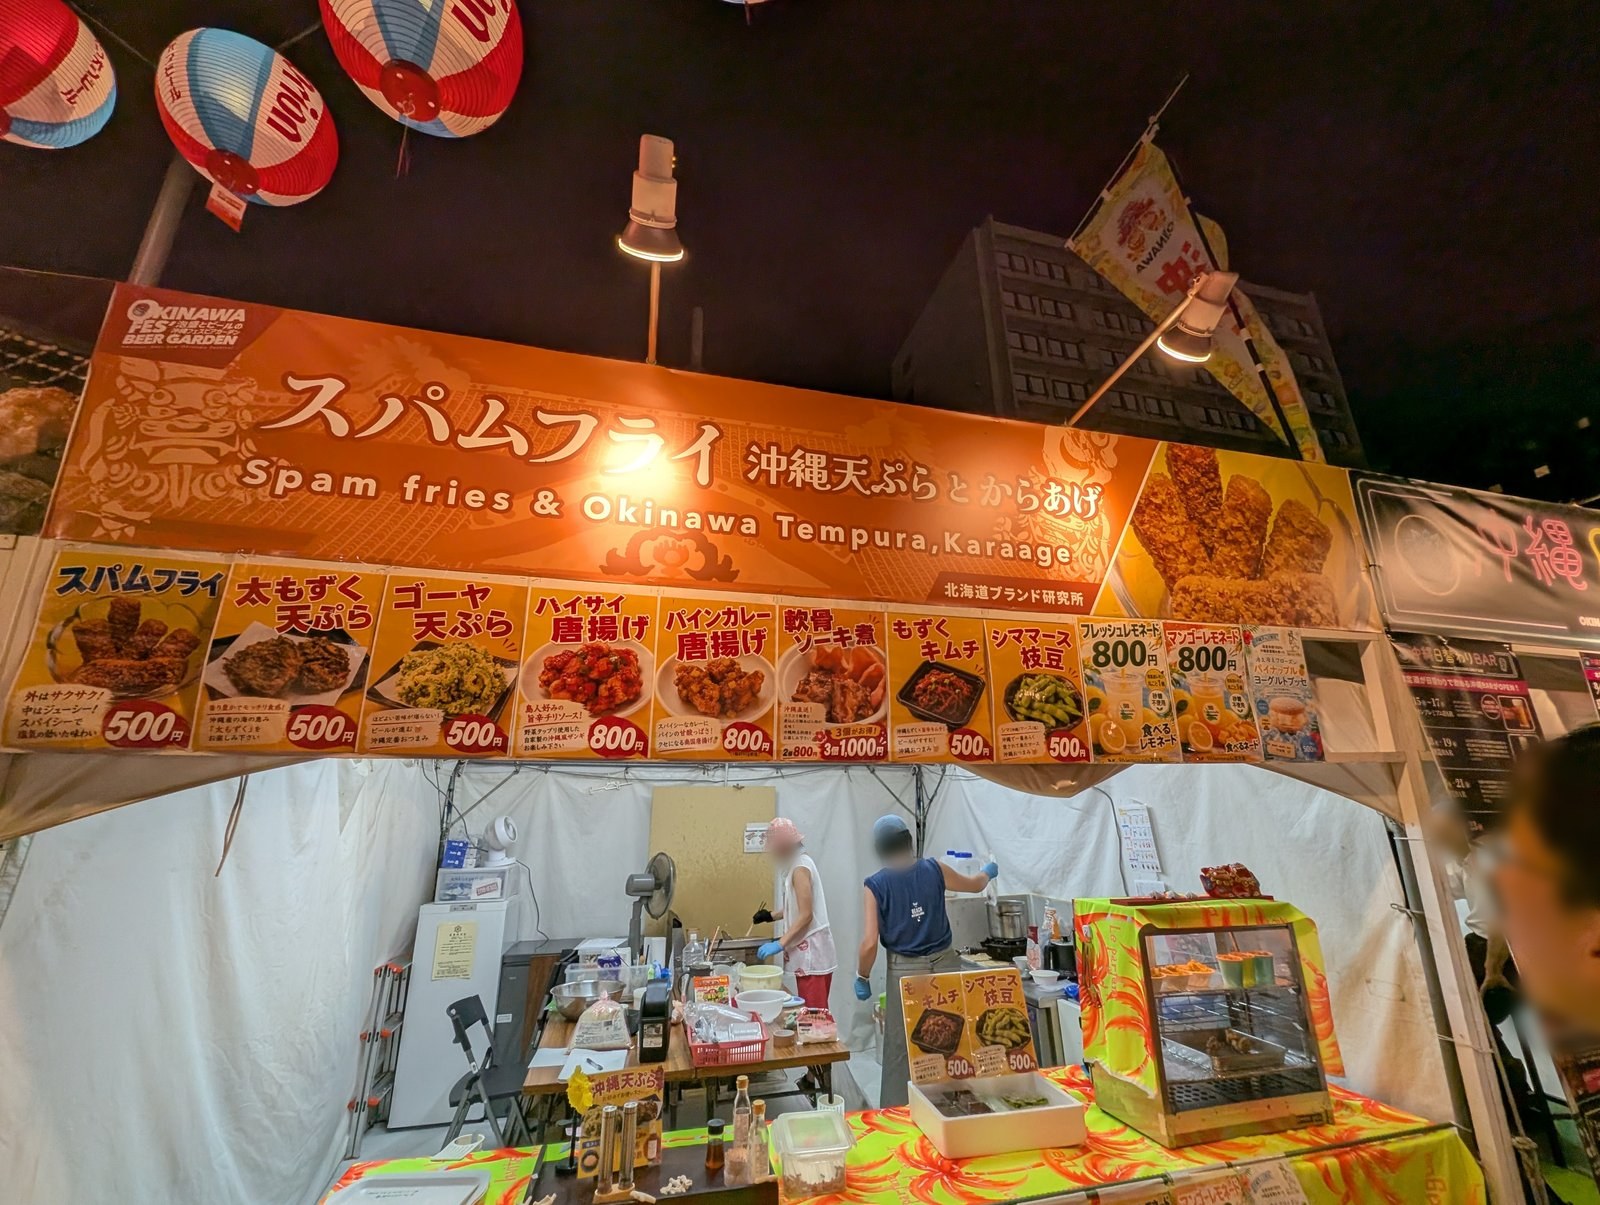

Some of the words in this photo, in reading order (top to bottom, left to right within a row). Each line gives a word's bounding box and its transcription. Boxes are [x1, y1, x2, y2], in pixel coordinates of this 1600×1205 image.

[127, 299, 246, 322] OKINAWA
[122, 334, 163, 344] BEER
[166, 335, 238, 345] GARDEN
[259, 375, 723, 487] スパムフライ
[241, 458, 376, 496] Spam
[403, 475, 510, 511] fries
[533, 490, 560, 516] &
[583, 494, 757, 536] Okinawa
[56, 563, 224, 599] スパムフライ
[234, 574, 365, 608] 太もずく
[393, 582, 492, 611] ゴーヤ
[534, 594, 626, 616] ハイサイ
[944, 582, 1085, 607] 北海道ブランド研究所
[274, 603, 373, 634] 天ぷら
[412, 609, 514, 641] 天ぷら
[550, 614, 651, 646] 唐揚げ
[665, 606, 771, 631] パインカレー
[783, 608, 833, 633] 軟骨
[892, 618, 950, 639] もずく
[1080, 622, 1160, 639] フレッシュレモネード
[676, 628, 767, 663] 唐揚げ
[792, 623, 877, 654] ソーキ煮
[991, 627, 1072, 649] シママース
[1167, 630, 1239, 645] マンゴーレモネード
[921, 639, 979, 662] キムチ
[1021, 645, 1065, 671] 枝豆
[1091, 640, 1158, 668] 800円
[1178, 646, 1237, 672] 800円
[104, 710, 184, 742] 500円
[288, 714, 354, 743] 500円
[446, 720, 502, 747] 500円
[590, 723, 644, 751] 800円
[1142, 723, 1171, 737] 食べる
[723, 728, 769, 751] 800円
[951, 734, 990, 756] 500円
[1049, 737, 1086, 758] 500円
[1140, 734, 1177, 750] レモネード
[904, 976, 939, 995] もく
[965, 974, 1018, 993] シママース
[922, 990, 959, 1008] キムチ
[984, 987, 1014, 1007] 枝豆
